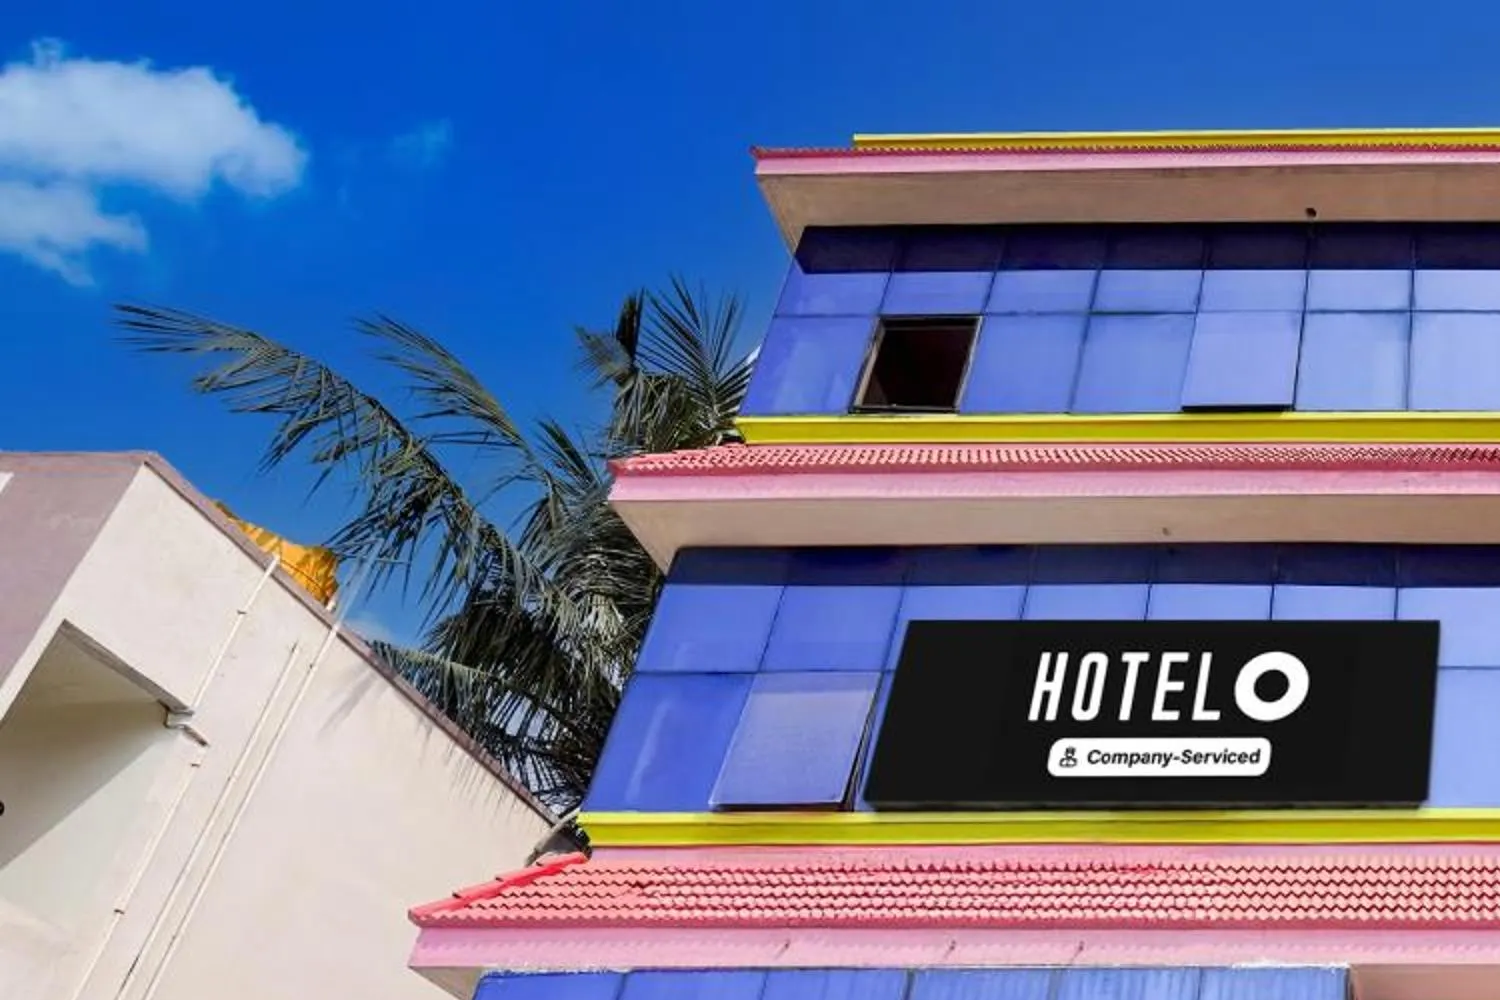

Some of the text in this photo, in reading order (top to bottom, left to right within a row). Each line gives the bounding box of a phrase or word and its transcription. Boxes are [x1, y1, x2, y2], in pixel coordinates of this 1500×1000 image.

[1028, 651, 1310, 722] HOTEL O
[1087, 748, 1261, 769] Company-Serviced
